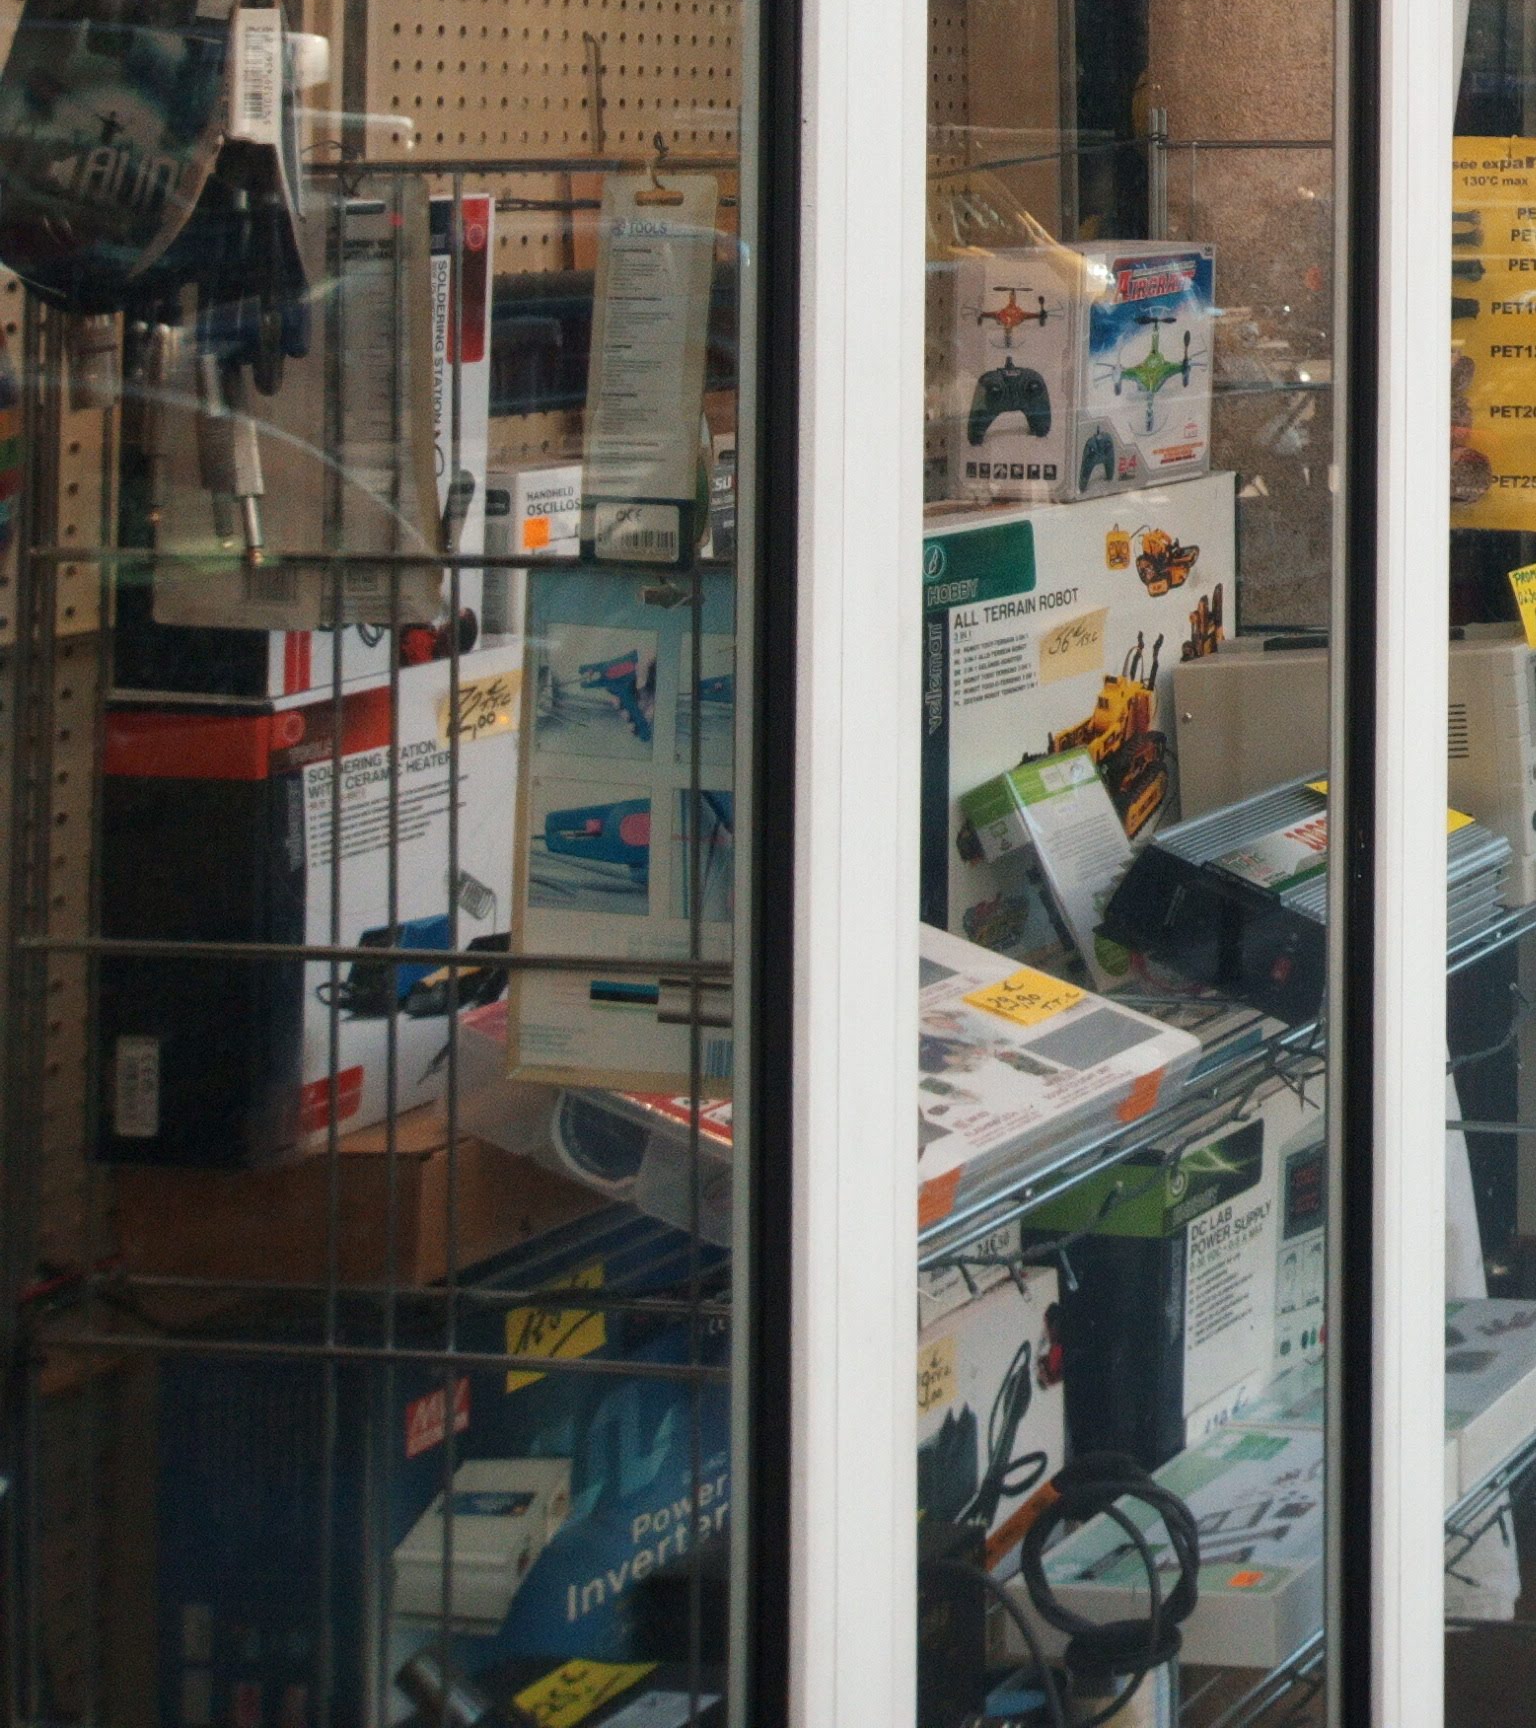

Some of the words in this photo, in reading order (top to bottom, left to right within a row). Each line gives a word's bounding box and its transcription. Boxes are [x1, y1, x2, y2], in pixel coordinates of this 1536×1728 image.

[1502, 178, 1528, 186] max
[433, 259, 448, 353] SOLDERING
[526, 486, 574, 502] HANDHELD
[927, 577, 980, 607] HOBBY
[953, 613, 979, 630] ALL
[984, 597, 1037, 624] TERRAIN
[1039, 587, 1079, 612] ROBOT
[925, 623, 943, 736] velleman
[1191, 1220, 1207, 1241] DC
[1209, 1206, 1233, 1231] LAB
[1191, 1224, 1232, 1259] POWER
[1233, 1199, 1272, 1235] SUPPLY
[632, 1468, 730, 1544] Power
[565, 1498, 730, 1623] Inverter
